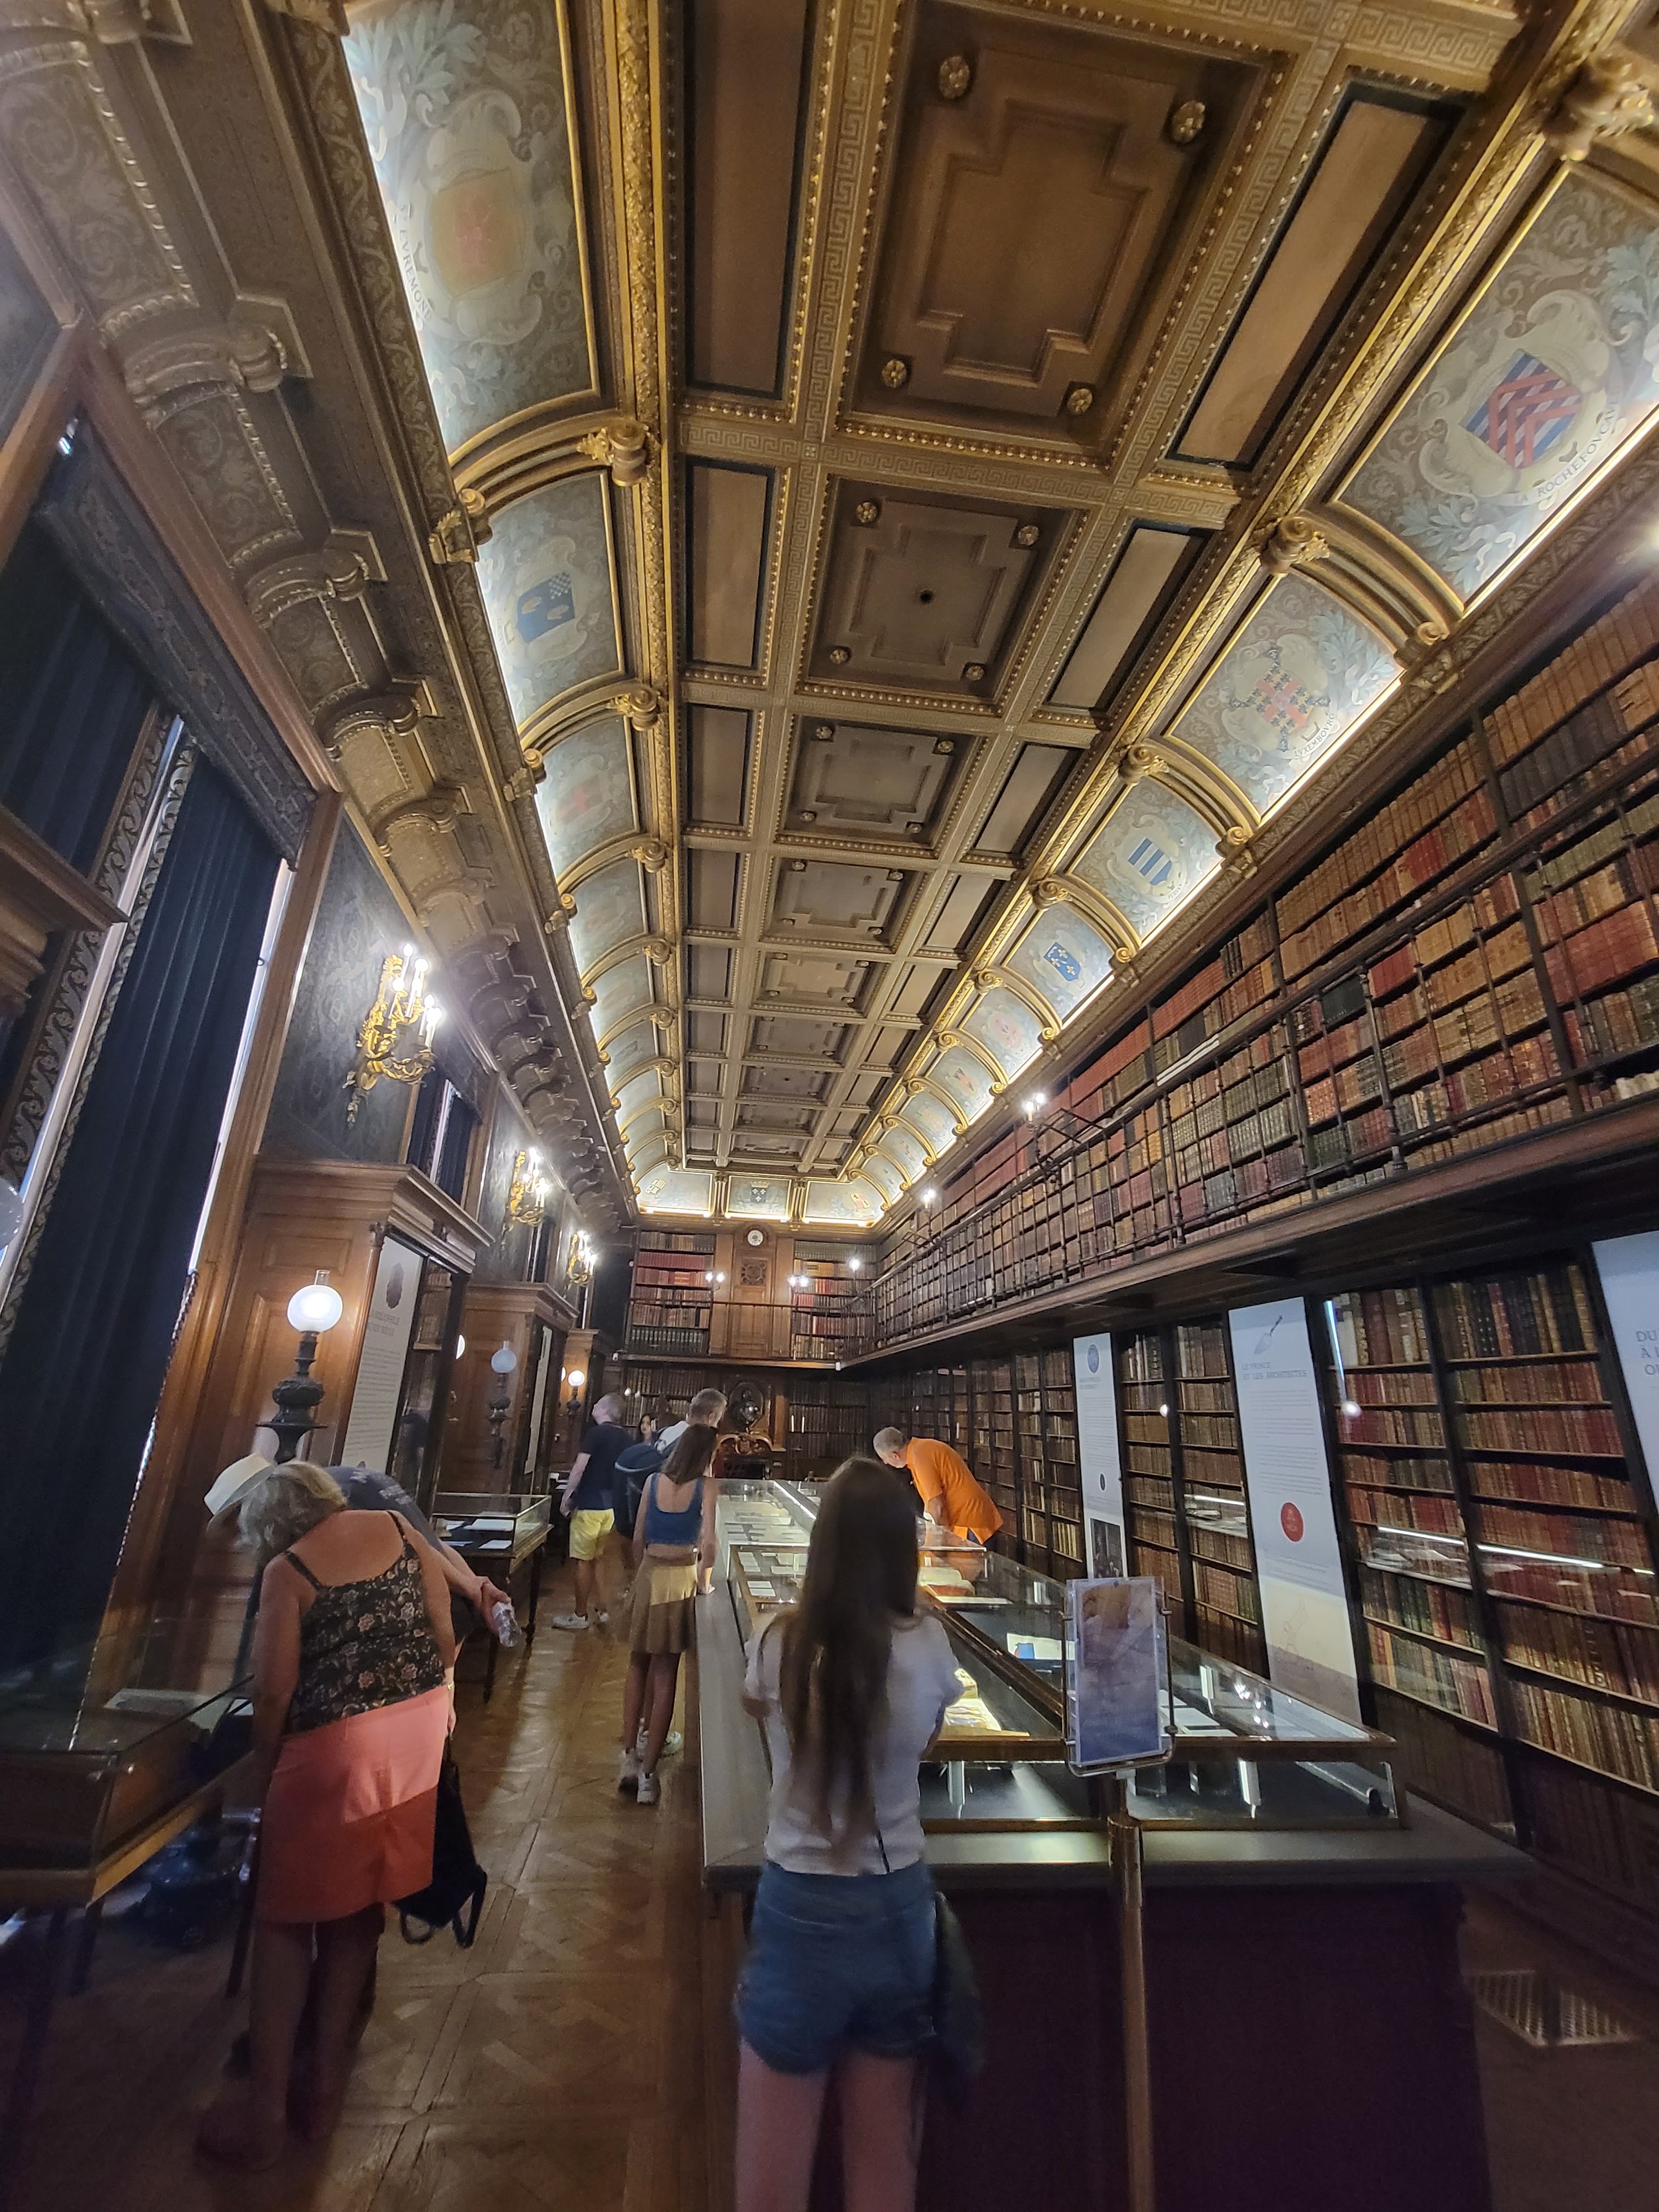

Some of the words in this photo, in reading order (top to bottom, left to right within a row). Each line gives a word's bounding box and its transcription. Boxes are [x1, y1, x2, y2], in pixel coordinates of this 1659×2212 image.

[399, 229, 432, 321] EVREMOND
[1295, 713, 1335, 757] LVXEMBOVRG
[1636, 1329, 1657, 1342] DU
